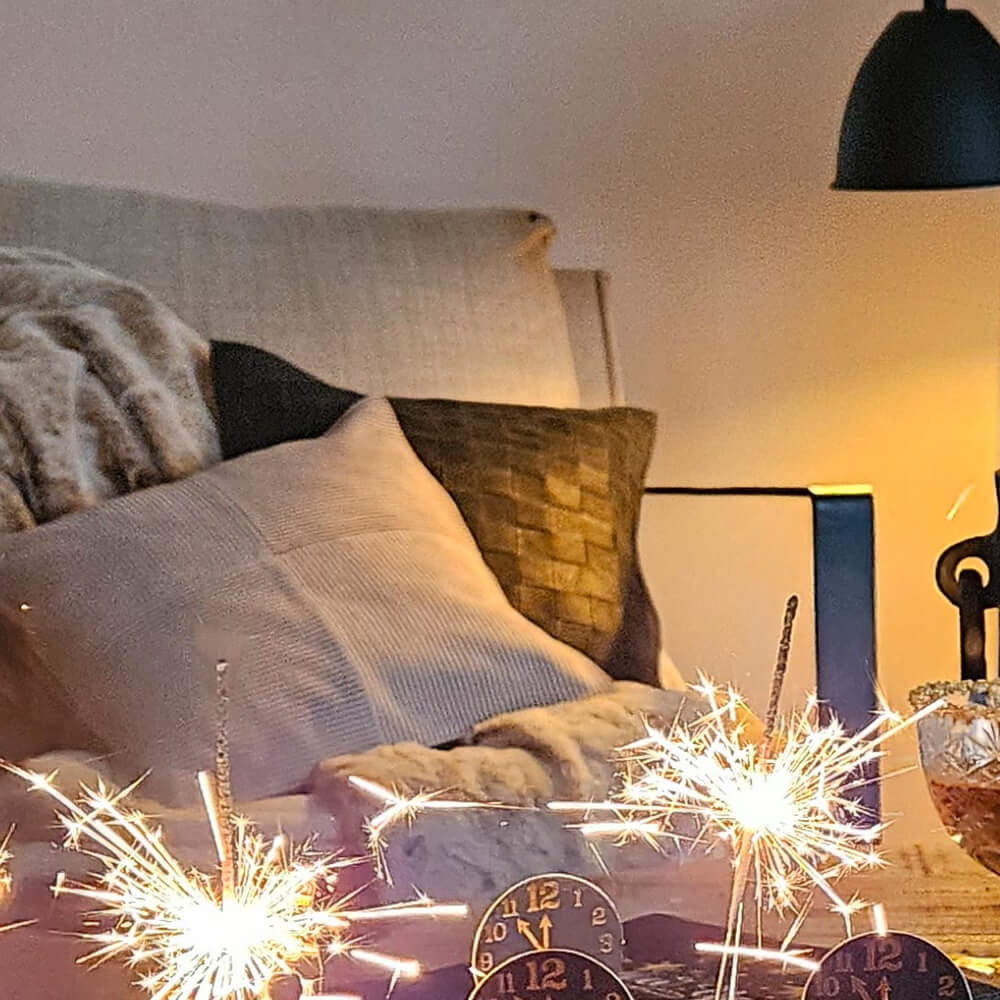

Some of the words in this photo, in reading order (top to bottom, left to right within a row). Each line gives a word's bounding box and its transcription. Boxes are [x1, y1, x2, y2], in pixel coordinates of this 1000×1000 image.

[526, 881, 561, 913] 12
[573, 889, 584, 907] 1
[502, 898, 520, 918] 11
[592, 907, 608, 926] 2
[484, 922, 507, 943] 10
[600, 933, 615, 953] 3
[480, 952, 494, 971] 9
[864, 938, 903, 972] 12
[918, 952, 928, 972] 1
[525, 958, 567, 991] 12
[582, 969, 593, 990] 1
[938, 975, 956, 997] 2
